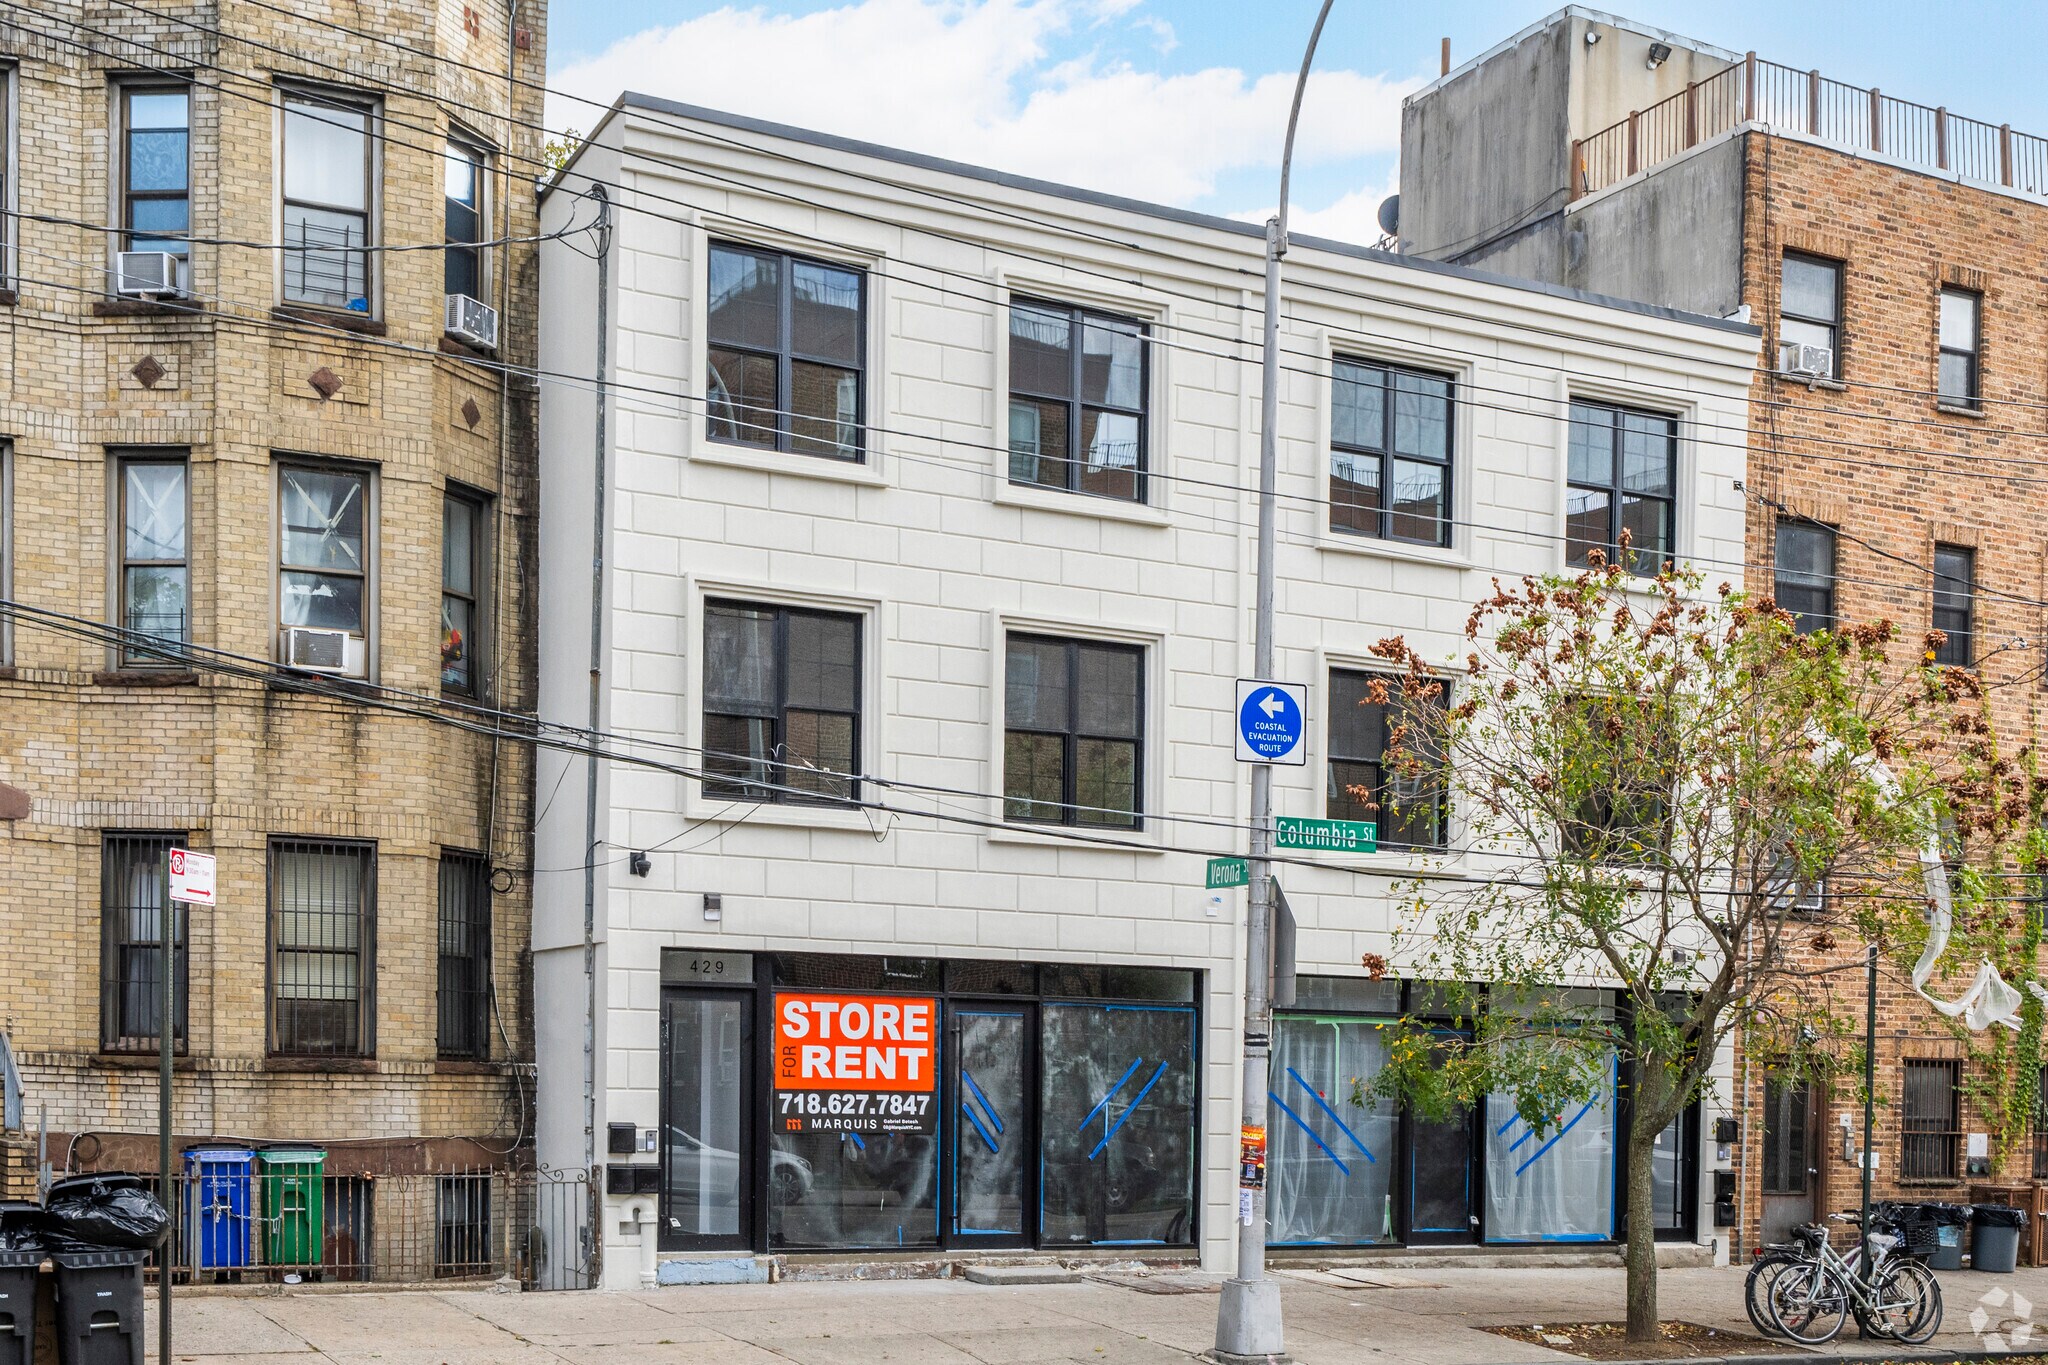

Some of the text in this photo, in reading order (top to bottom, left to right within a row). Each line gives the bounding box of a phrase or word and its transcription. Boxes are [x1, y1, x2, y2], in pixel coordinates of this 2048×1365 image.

[1255, 721, 1287, 732] COASTAL
[1248, 731, 1293, 743] EVACUATION
[1259, 743, 1282, 753] ROUTE
[1277, 820, 1374, 849] Columbia St
[1211, 863, 1240, 885] Verona
[690, 960, 724, 974] 429
[1654, 1000, 1675, 1011] 31
[782, 1000, 929, 1041] STORE
[782, 1045, 797, 1078] FOR
[801, 1044, 929, 1080] RENT
[778, 1093, 930, 1116] 718.627.7847
[811, 1118, 878, 1131] MARQUIS
